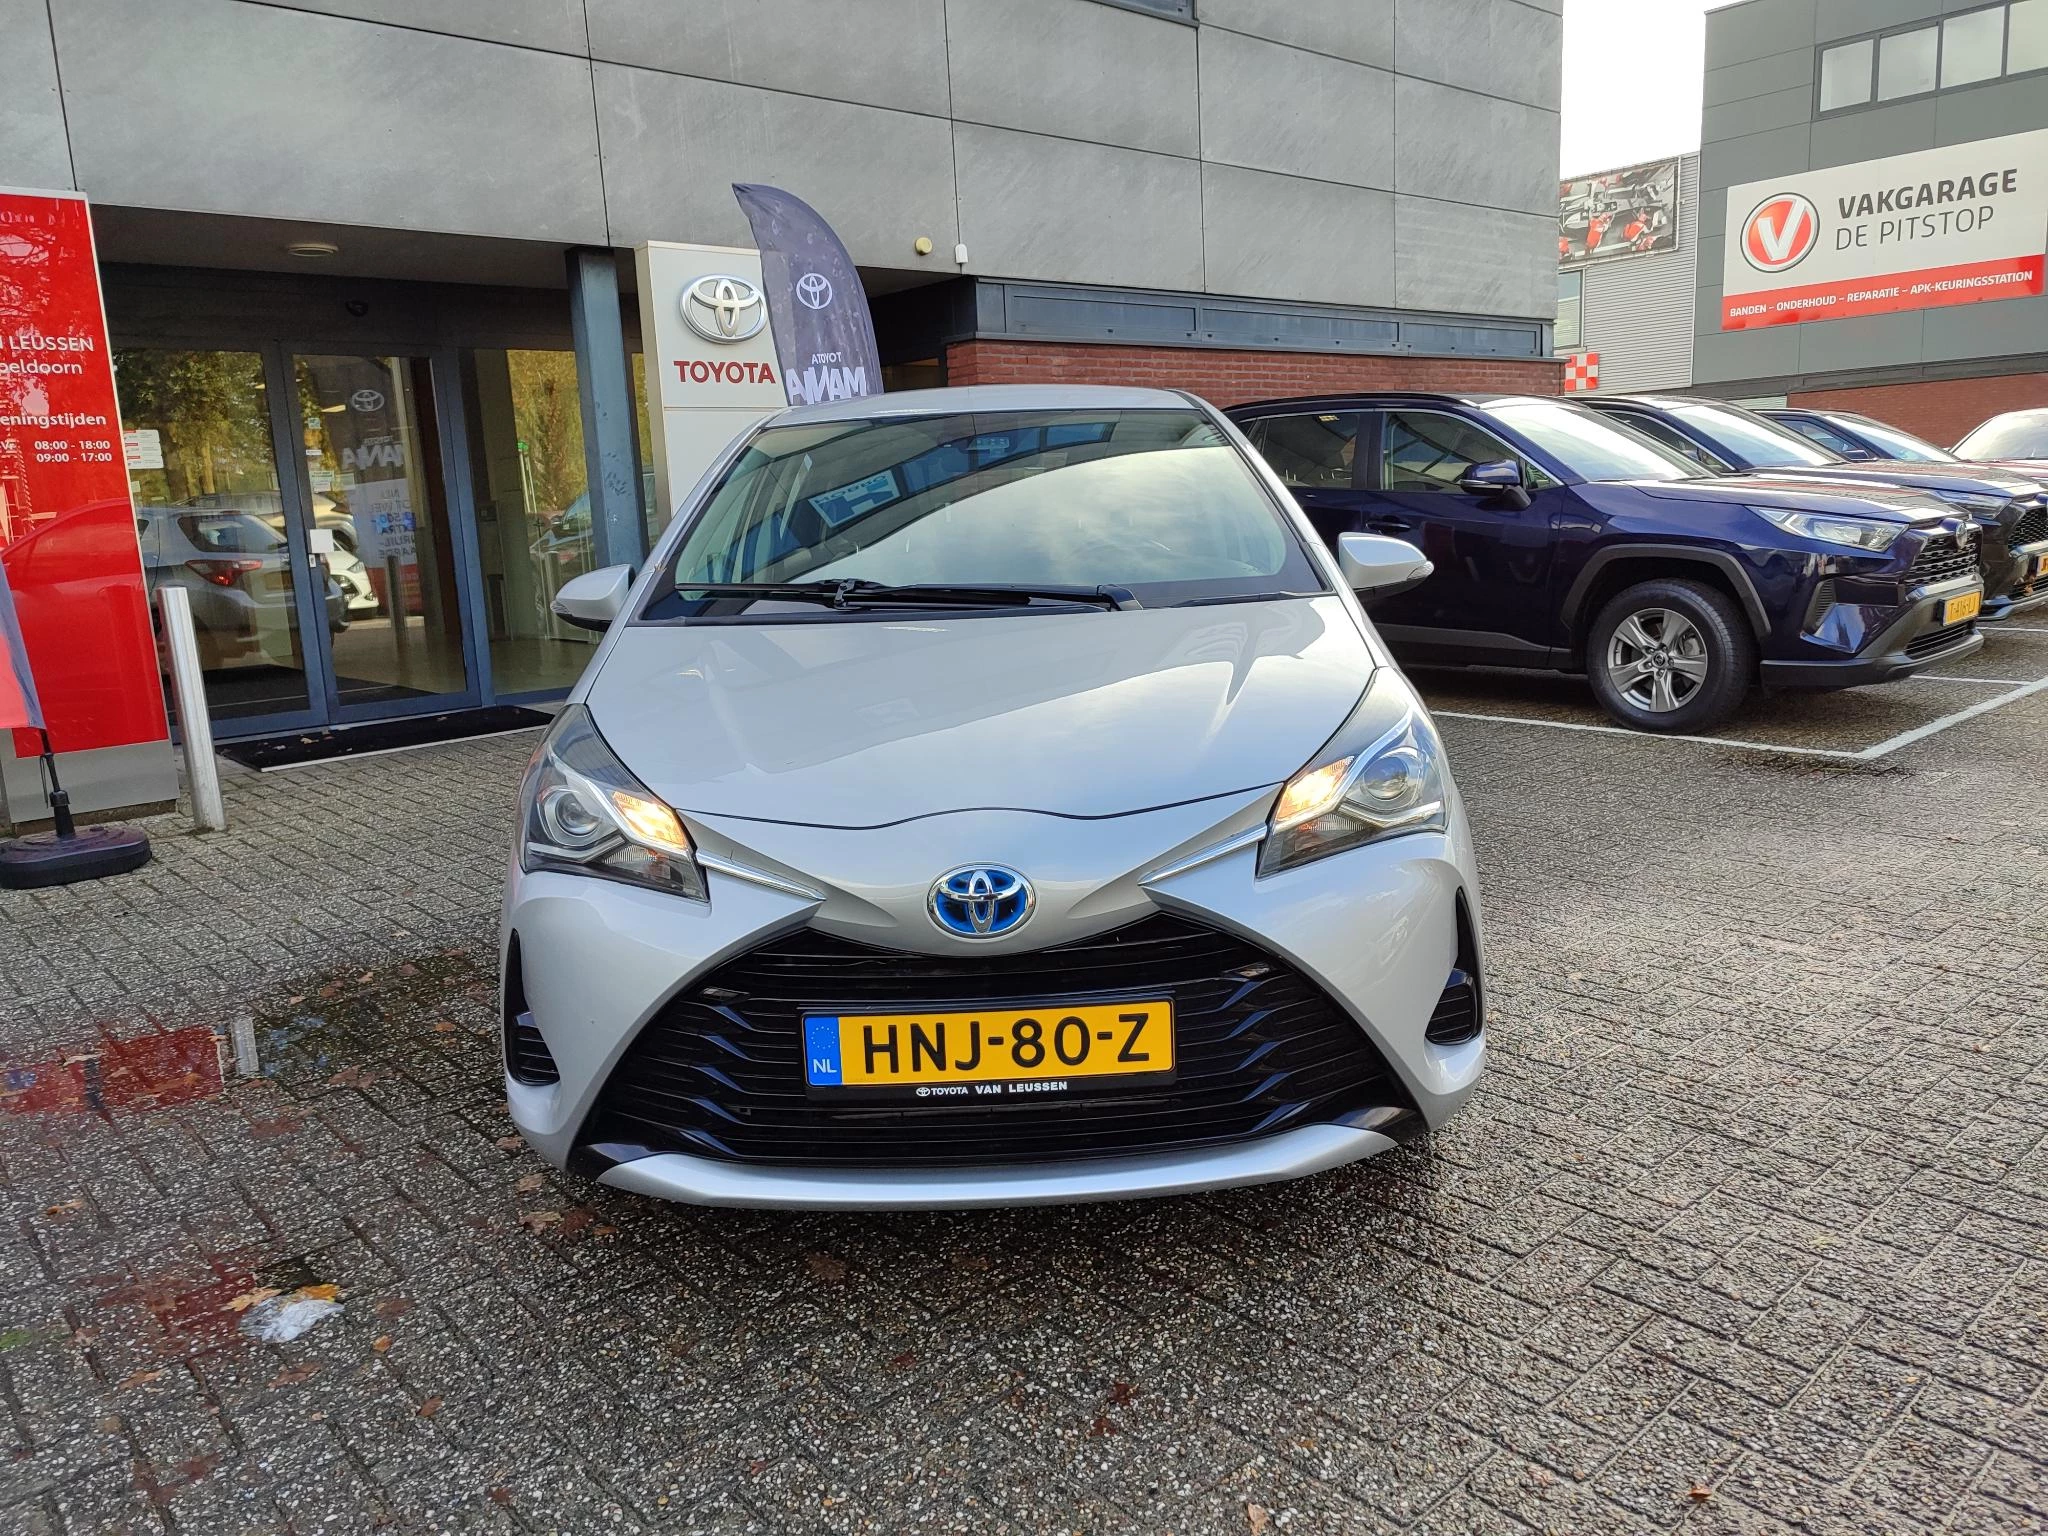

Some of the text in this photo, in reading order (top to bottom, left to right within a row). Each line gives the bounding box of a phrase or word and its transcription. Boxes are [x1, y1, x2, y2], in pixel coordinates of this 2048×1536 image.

[1838, 168, 2018, 219] VAKGARAGE
[1836, 205, 1994, 250] DE PITSTOP
[1730, 303, 1767, 317] BANDEN
[1776, 295, 1837, 311] ONDERHOUD
[1847, 286, 1900, 303] REPARATIE
[1910, 271, 2033, 295] APK-KEURINGSSTATION
[9, 336, 94, 351] LEUSSEN
[673, 360, 776, 384] TOYOTA
[34, 440, 68, 450] 08:00
[79, 440, 111, 450] 18:00
[36, 453, 69, 462] 09:00
[81, 452, 112, 462] 17:00
[862, 1012, 1150, 1075] HNJ-80-Z
[813, 1059, 837, 1074] NL
[932, 1081, 1068, 1096] TOYOTA VAN LEUSSEN
